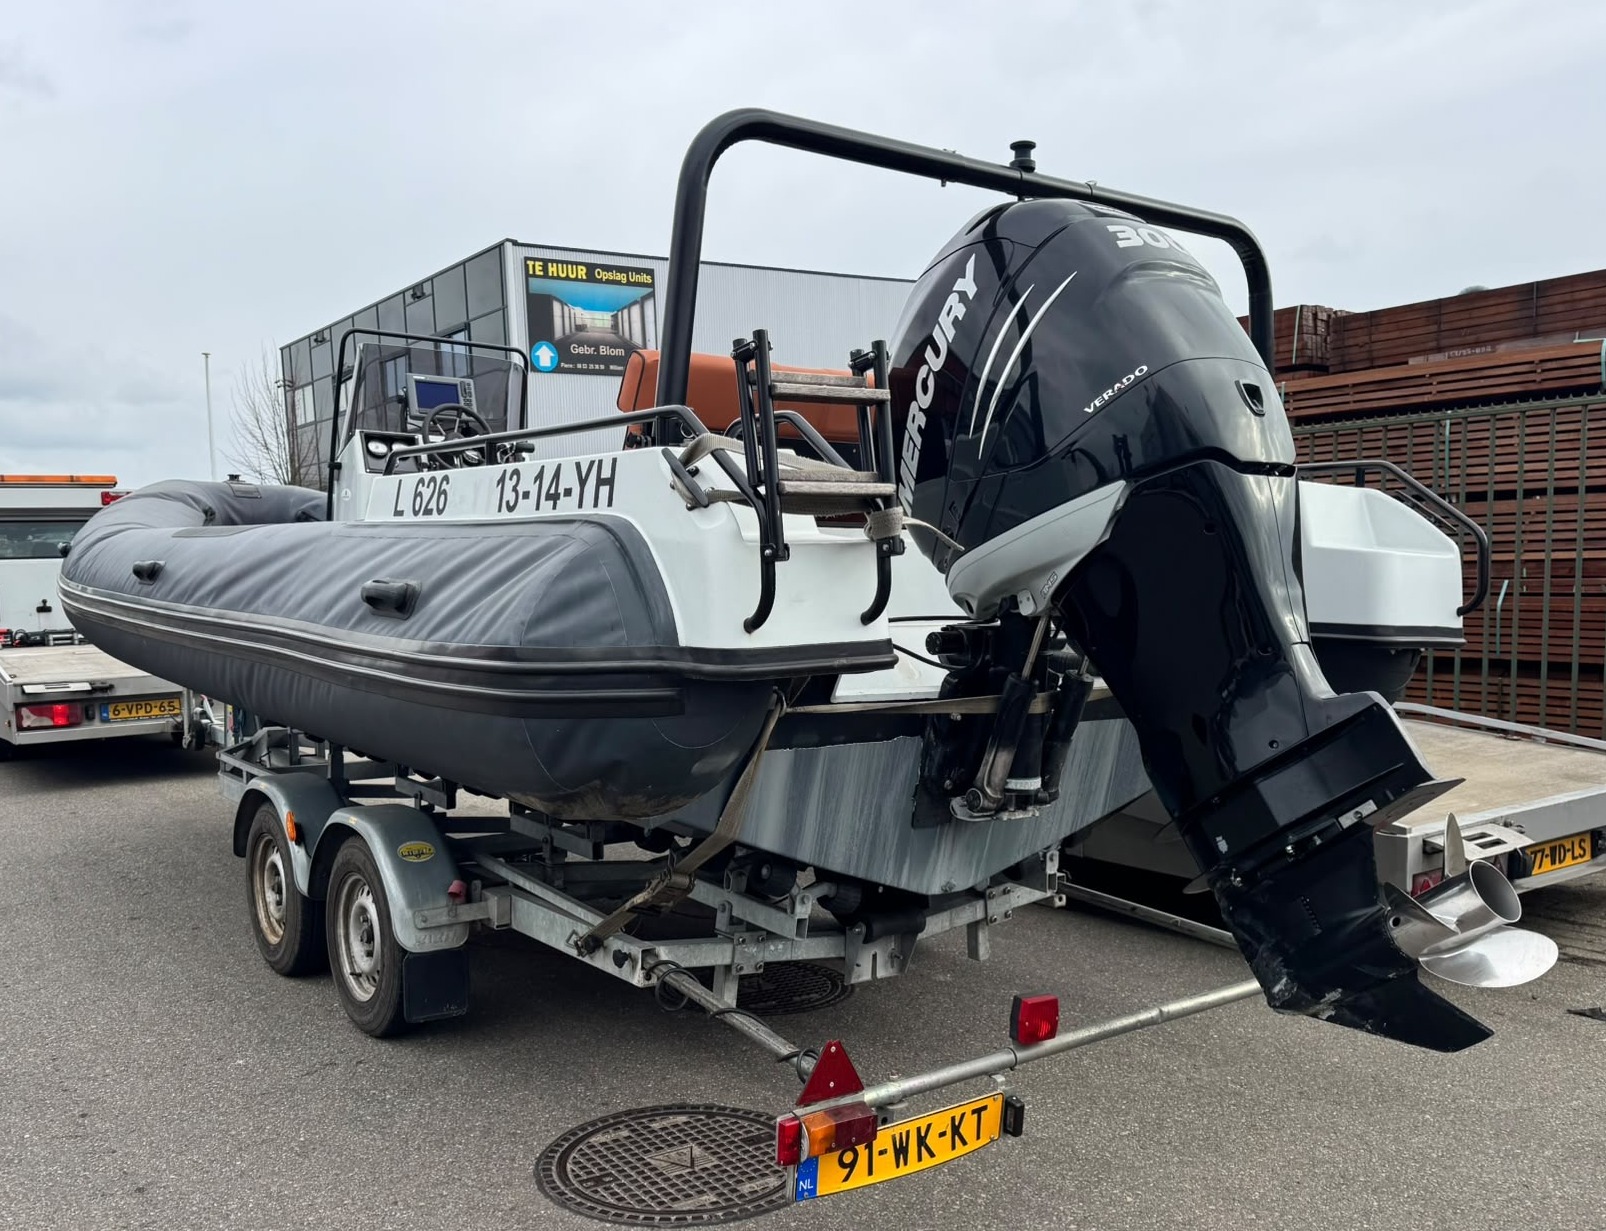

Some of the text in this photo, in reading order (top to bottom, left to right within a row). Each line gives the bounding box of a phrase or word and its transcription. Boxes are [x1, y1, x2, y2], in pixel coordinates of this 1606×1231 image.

[526, 260, 653, 284] TE HUUR Opslag Units
[570, 343, 625, 356] Gebr. Blom
[897, 252, 979, 515] MERCURY
[1083, 364, 1149, 414] VERADO
[393, 456, 618, 517] L 626 13-14-YH
[112, 700, 177, 717] 6-VPD-65
[1530, 838, 1587, 871] 77-WD-LS
[837, 1104, 989, 1183] 91-WK-KT
[798, 1178, 814, 1192] NL
